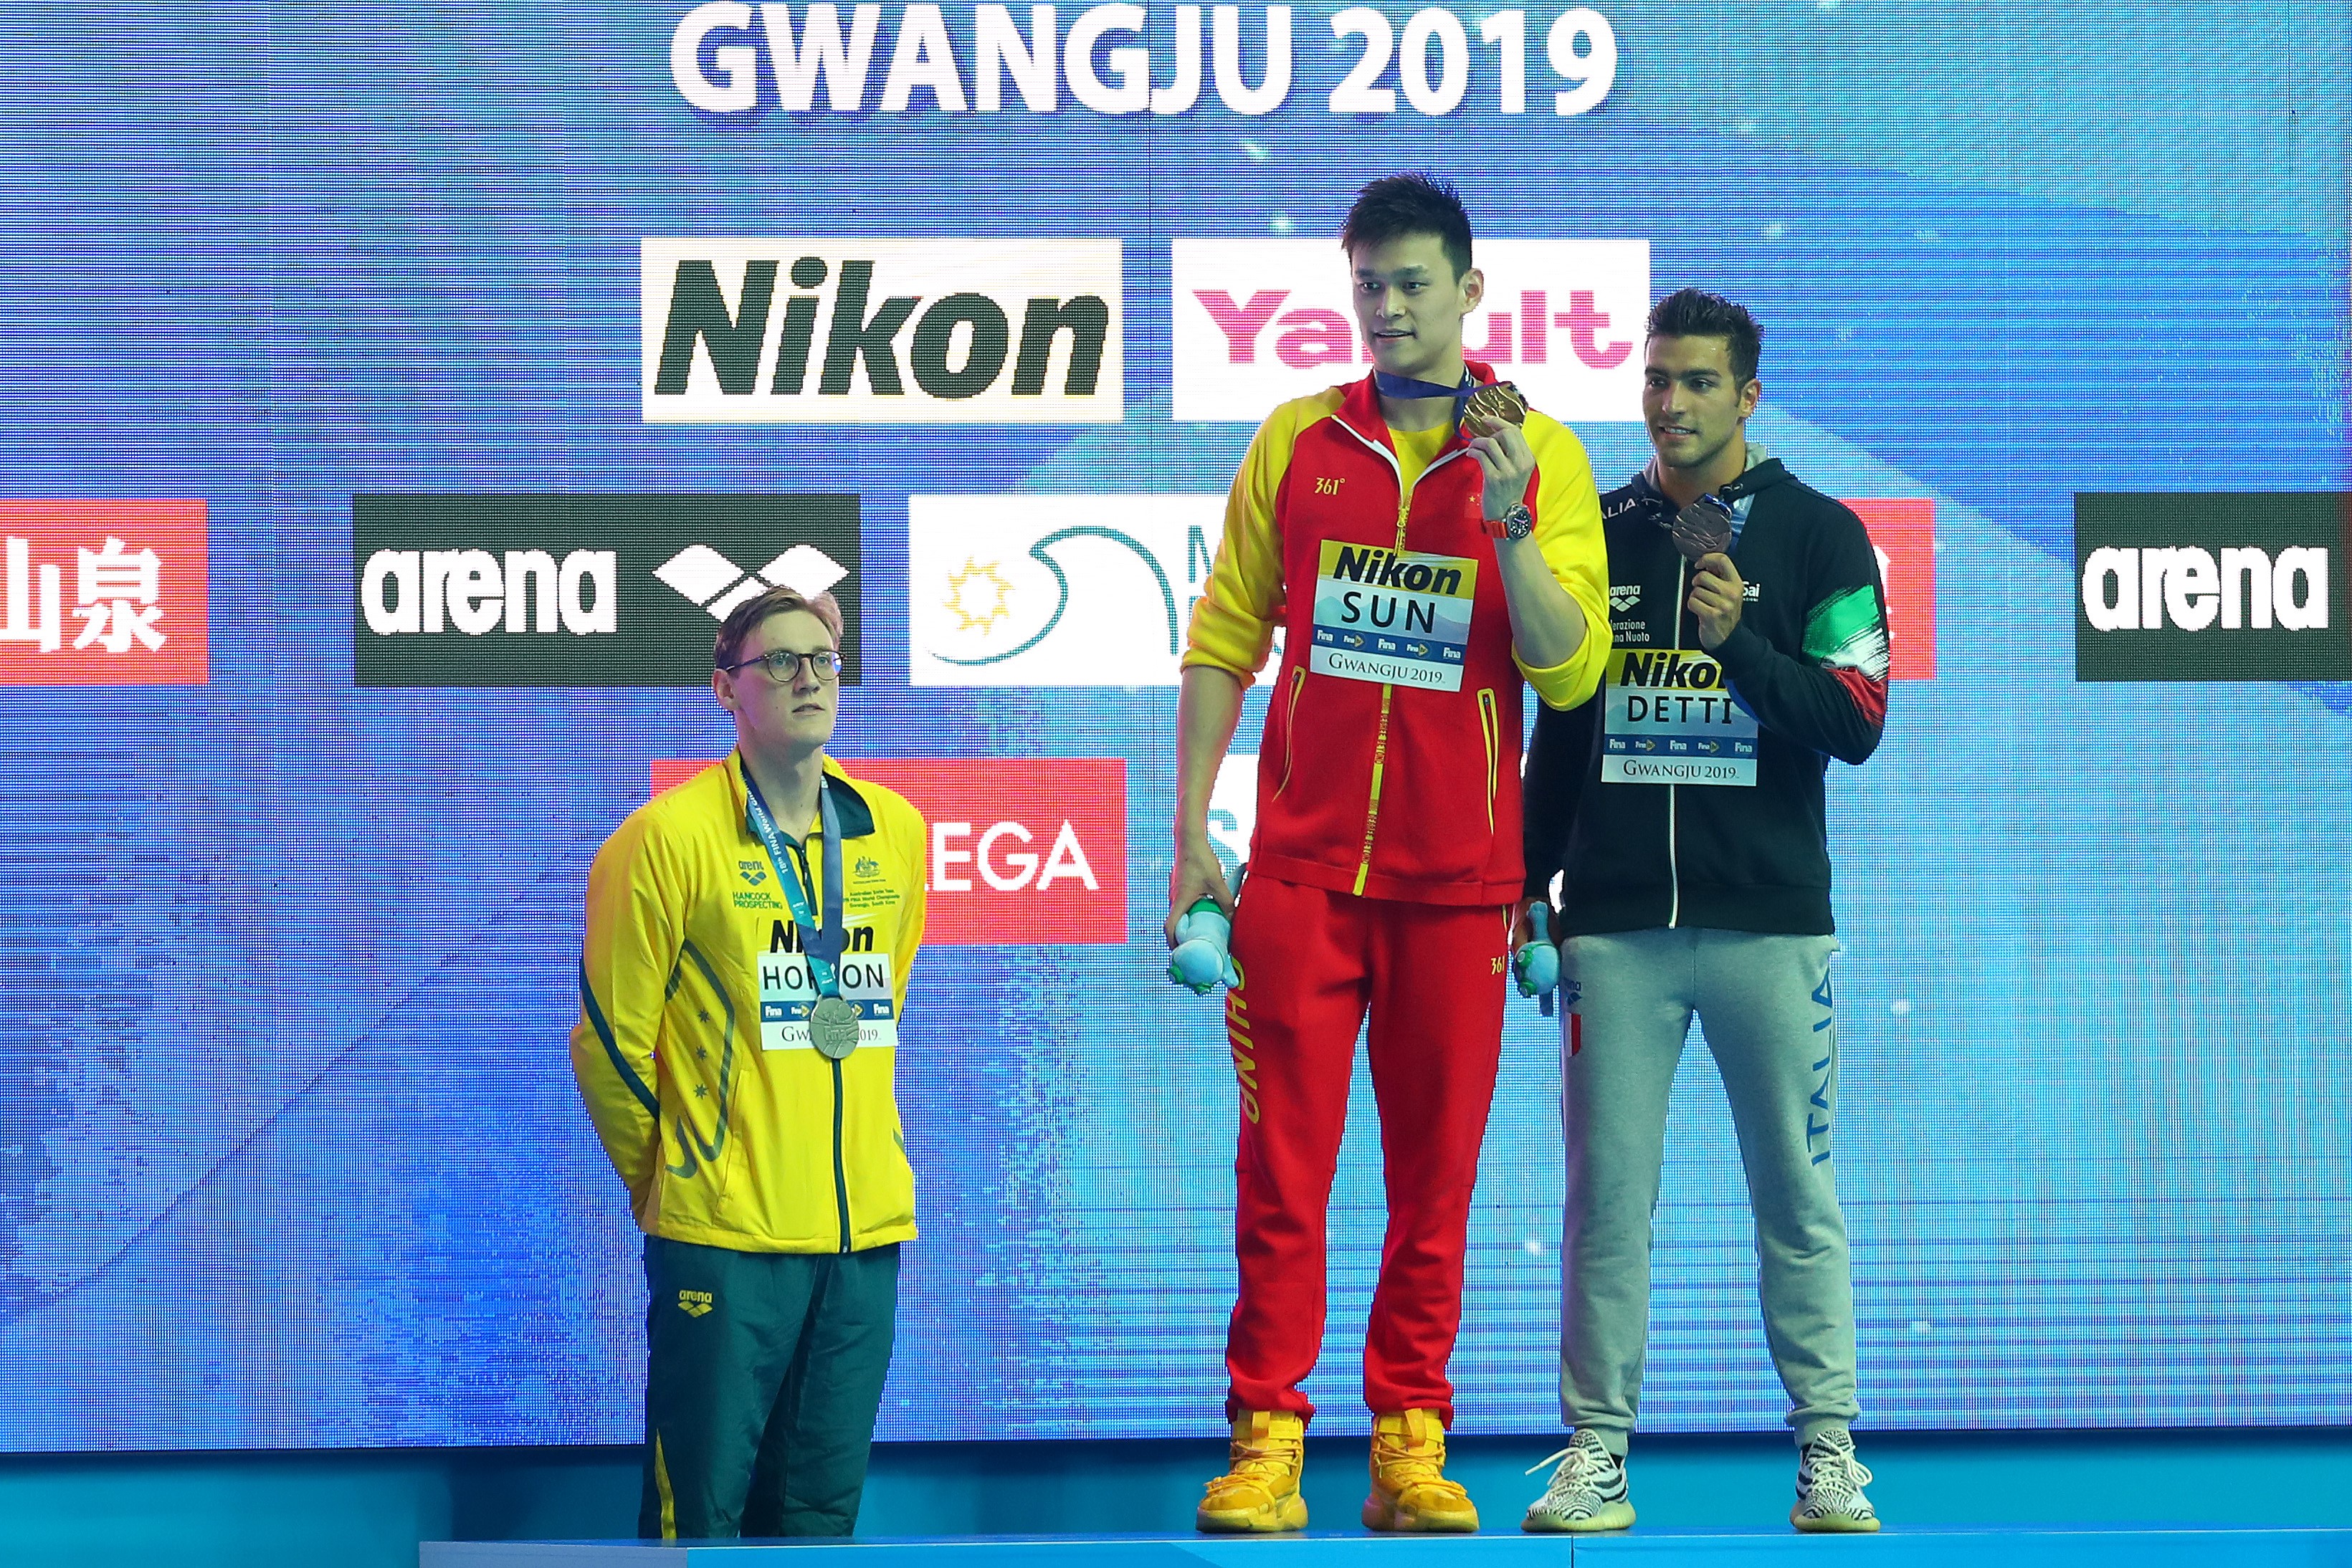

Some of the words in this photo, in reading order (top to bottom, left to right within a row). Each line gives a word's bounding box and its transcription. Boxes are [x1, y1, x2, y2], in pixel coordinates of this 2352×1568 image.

[670, 2, 1291, 115] GWANGJU
[1327, 6, 1618, 116] 2019
[654, 257, 1110, 399] Nikon
[1192, 289, 1633, 369] Yault
[1333, 546, 1462, 595] Nikon
[361, 547, 617, 636] arena
[1610, 585, 1641, 596] arena
[2081, 545, 2329, 631] arena
[1341, 591, 1436, 634] SUN
[1317, 629, 1333, 642] Fina
[1378, 639, 1396, 651] Fina
[1443, 646, 1461, 659] Fina
[1626, 631, 1649, 642] Nuoto
[1411, 668, 1443, 684] 2019
[1620, 652, 1726, 689] Niko
[1627, 695, 1732, 724] DETTI
[1609, 739, 1626, 750] Fina
[1670, 740, 1687, 750] Fina
[1735, 742, 1753, 752] Fina
[1705, 765, 1736, 778] 2019
[925, 818, 1099, 891] EGA
[763, 964, 884, 990] HOON
[765, 1006, 782, 1017] Fina
[874, 1004, 890, 1015] Fina
[858, 1029, 878, 1041] 019
[1806, 964, 1833, 1167] ITALIA
[680, 1290, 712, 1303] arena
